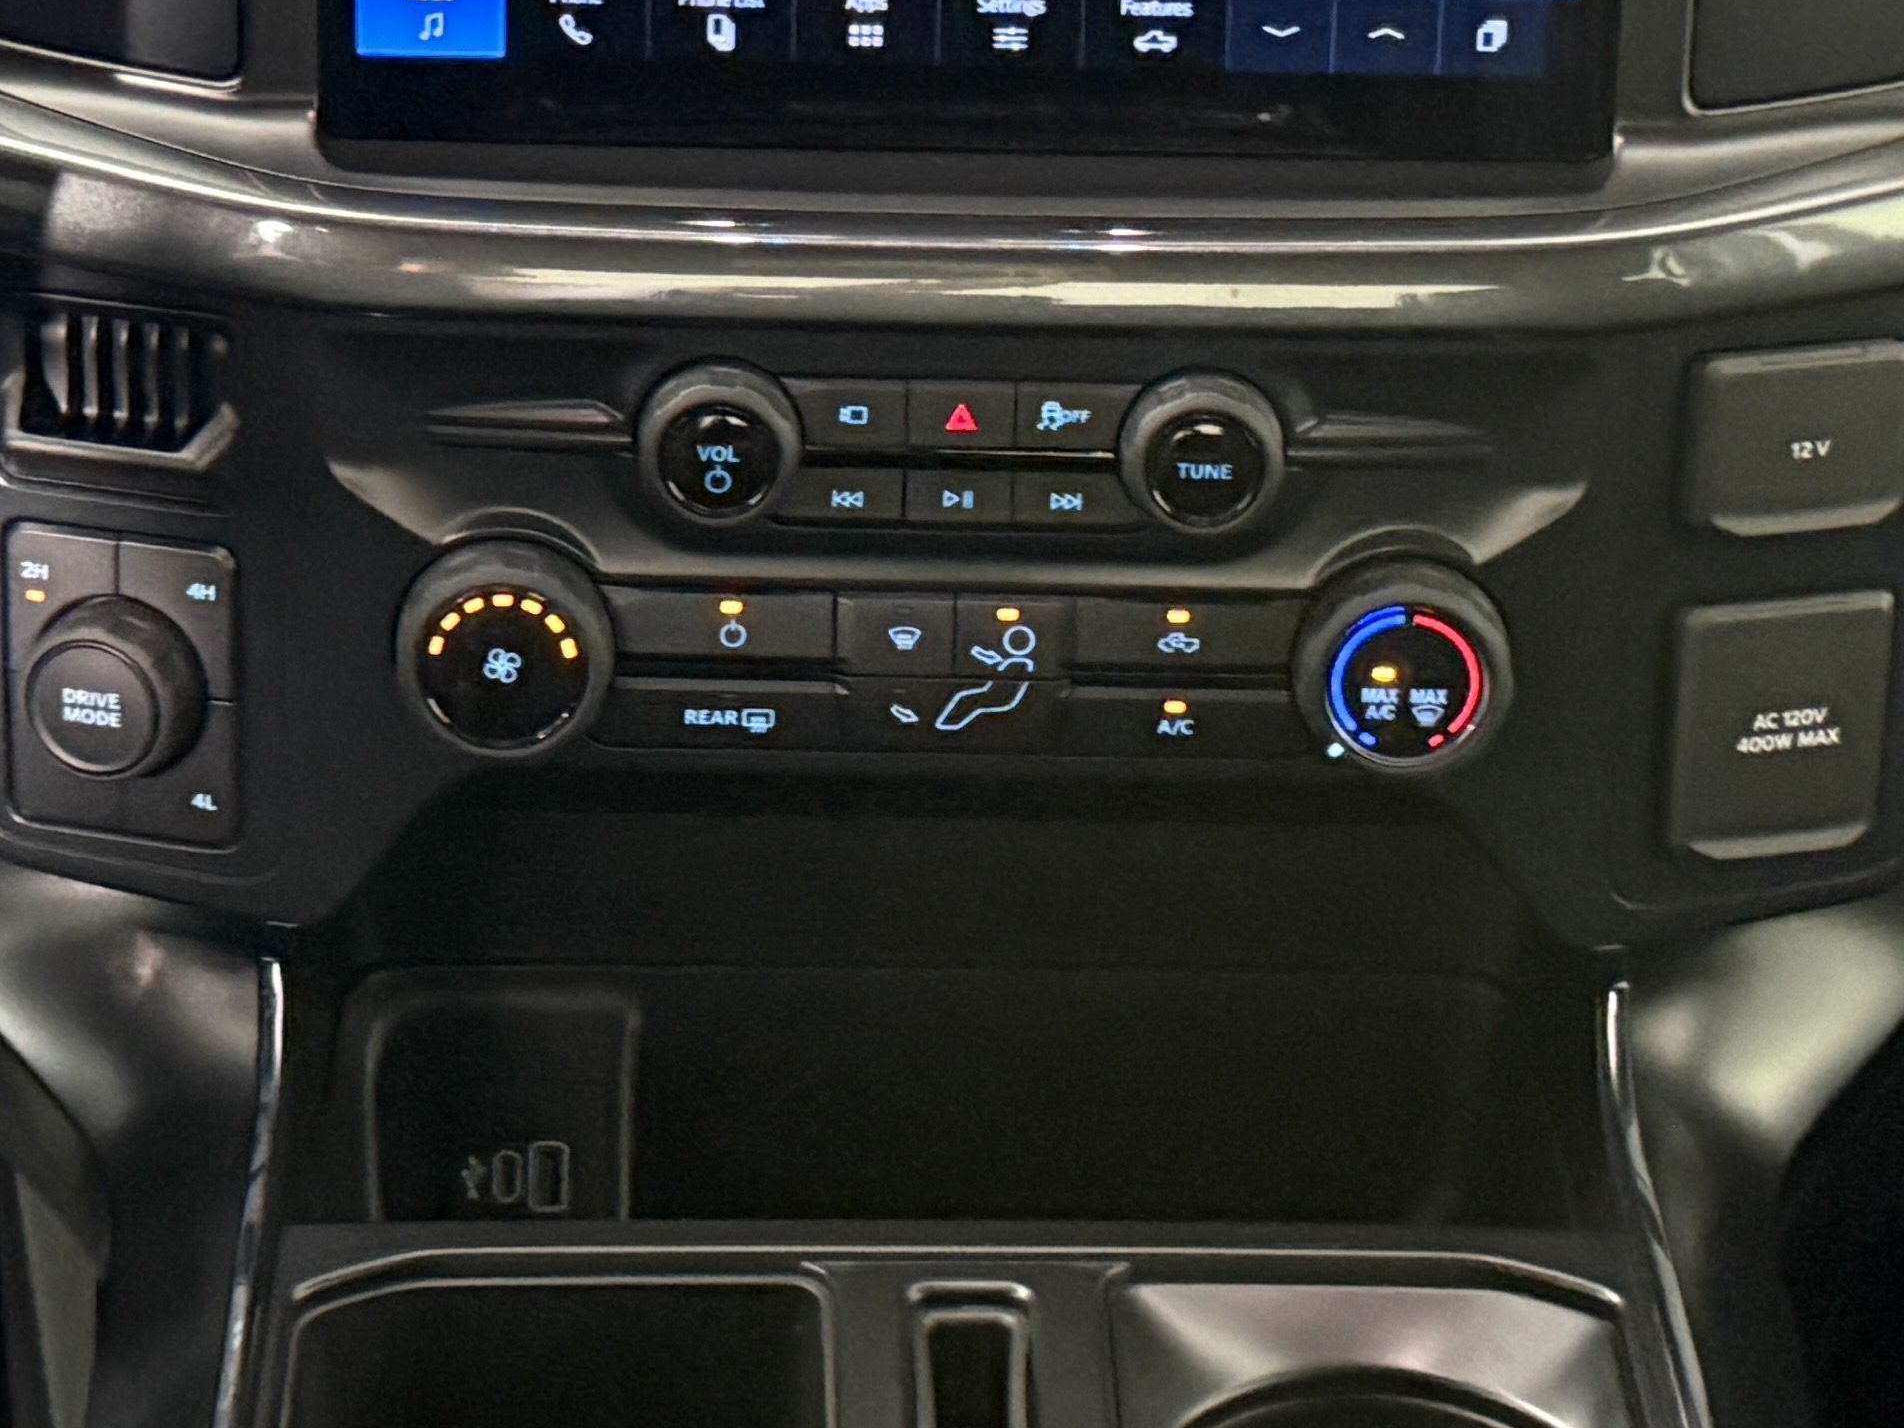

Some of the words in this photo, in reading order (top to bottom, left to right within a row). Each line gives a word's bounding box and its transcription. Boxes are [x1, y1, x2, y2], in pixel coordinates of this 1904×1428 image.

[697, 445, 740, 464] VOL
[1176, 462, 1233, 481] TUNE
[20, 561, 49, 580] 2H
[186, 582, 216, 601] 4H
[62, 687, 121, 709] DRIVE
[1361, 687, 1400, 704] MAX
[1409, 687, 1448, 705] MAX
[62, 707, 122, 728] MODE
[684, 709, 738, 726] REAR
[1157, 719, 1194, 735] A/C
[1753, 713, 1779, 732] AC
[1781, 706, 1829, 728] 120V
[1736, 732, 1792, 754] 400W
[1796, 727, 1842, 748] MAX
[191, 792, 218, 811] 4L
